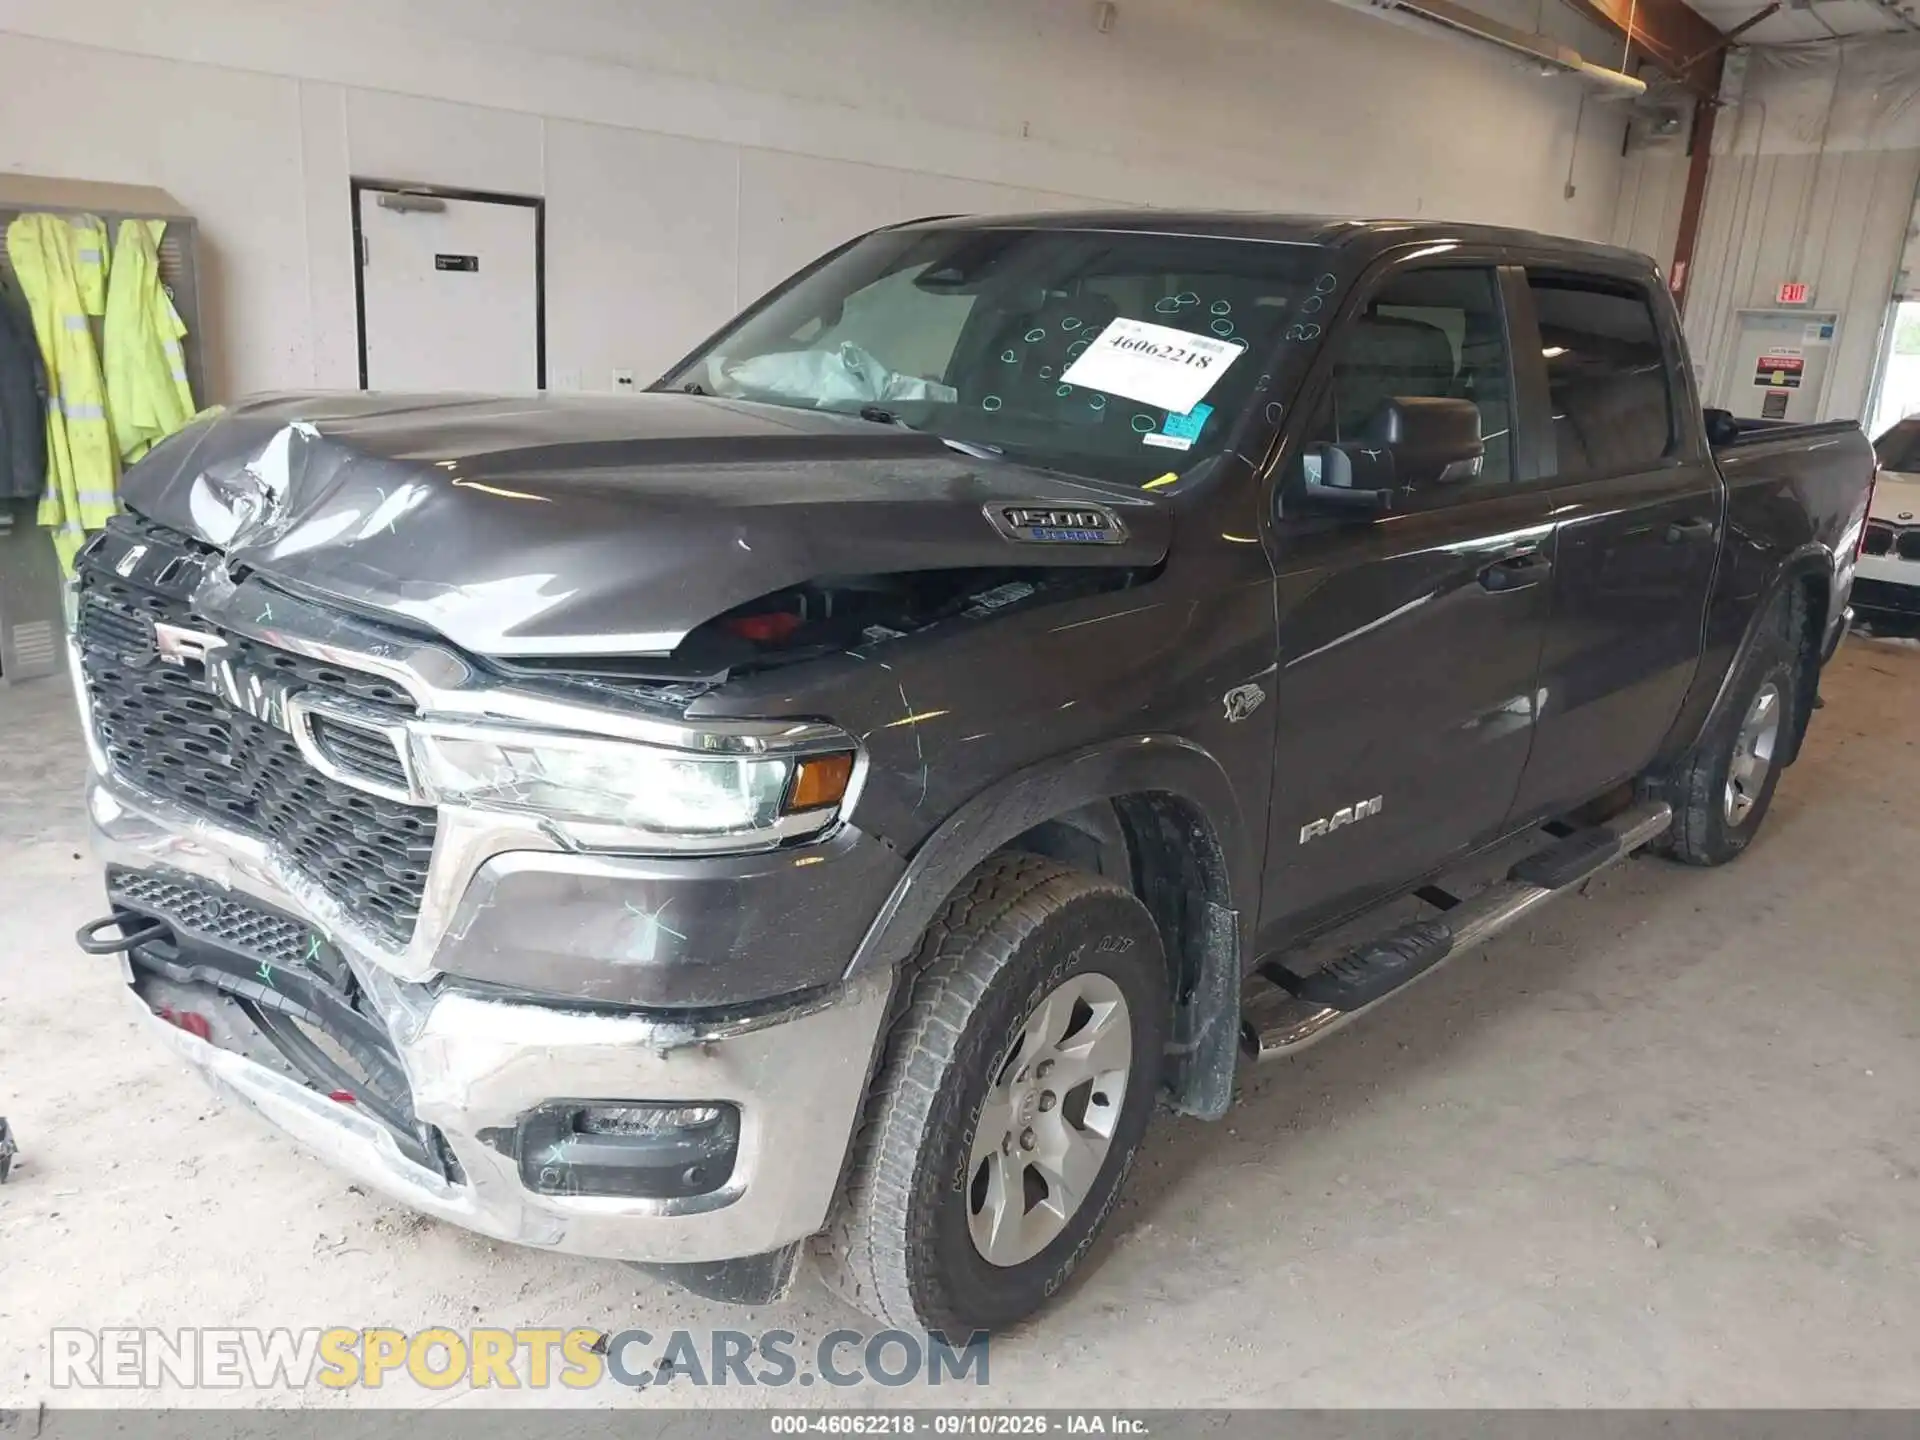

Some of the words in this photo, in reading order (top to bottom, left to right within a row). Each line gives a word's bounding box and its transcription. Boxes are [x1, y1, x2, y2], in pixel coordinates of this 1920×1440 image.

[1781, 284, 1805, 300] EXIT
[1109, 335, 1213, 369] 46062218
[1003, 508, 1099, 528] 1500
[1299, 795, 1383, 845] RAM
